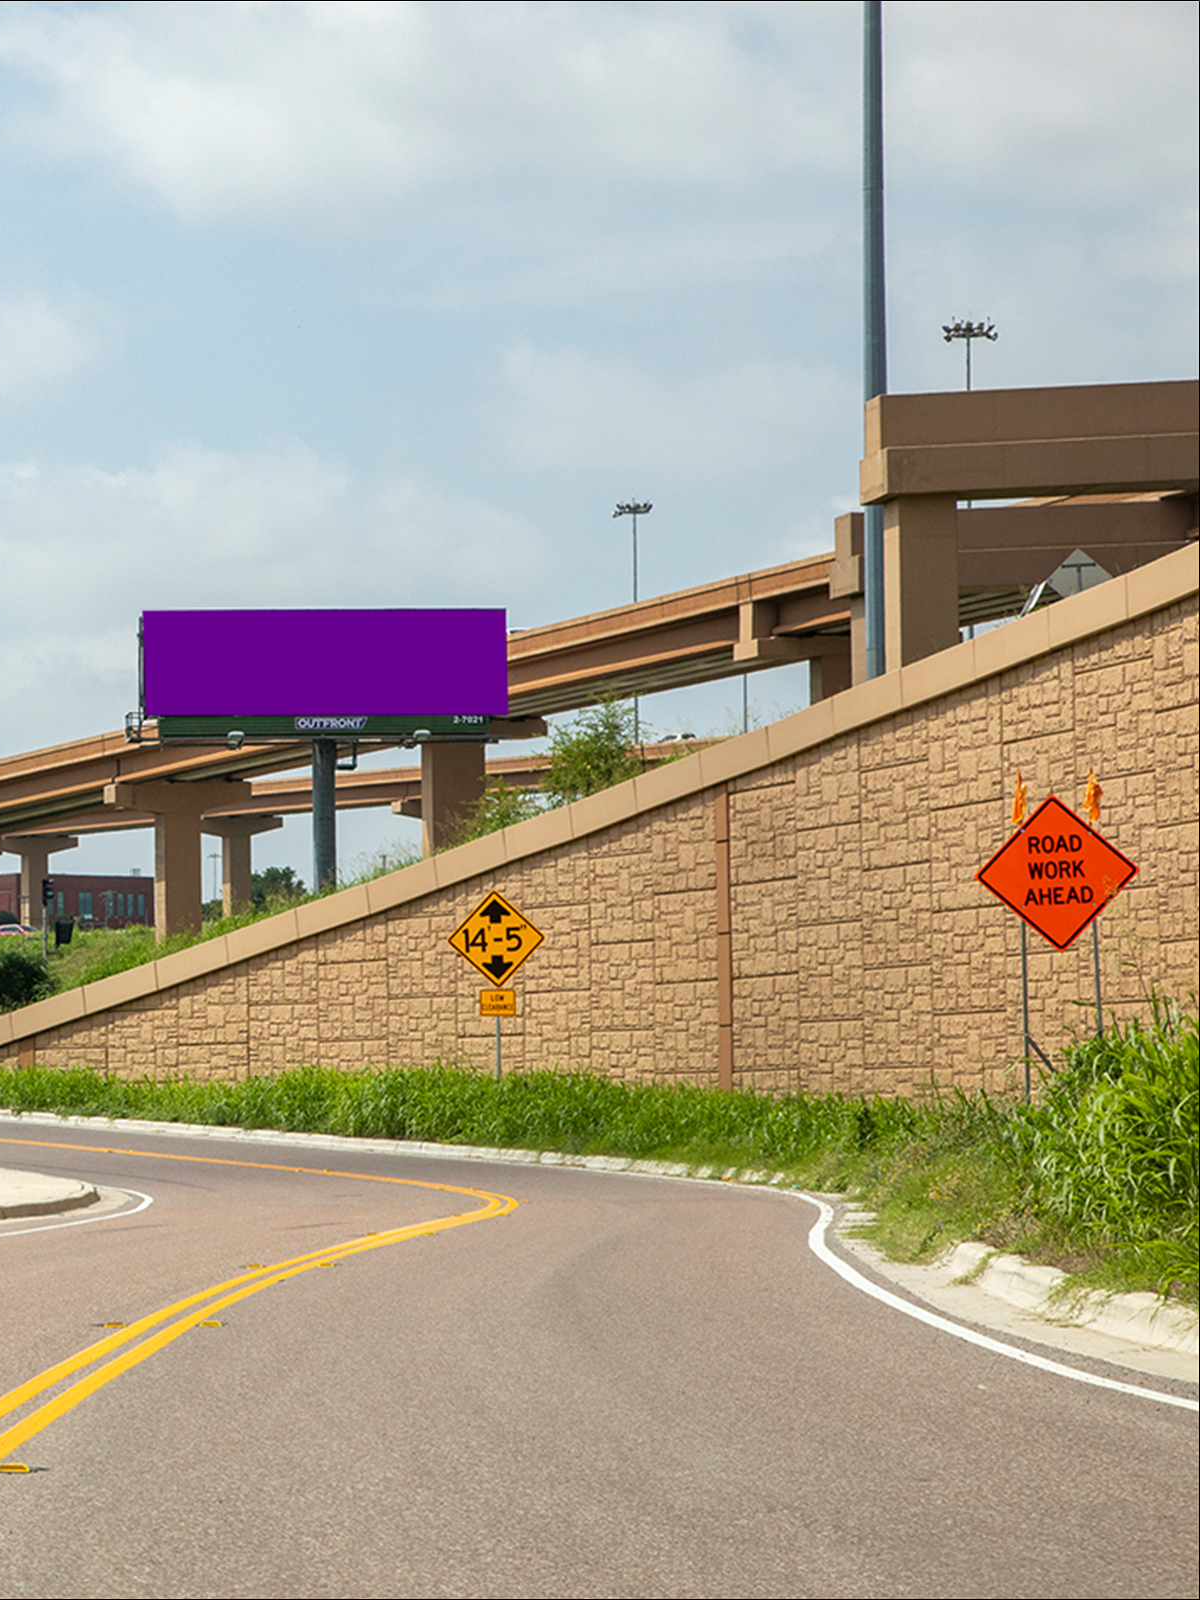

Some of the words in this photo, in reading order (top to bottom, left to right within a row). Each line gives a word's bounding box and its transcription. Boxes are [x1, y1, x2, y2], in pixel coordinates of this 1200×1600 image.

[297, 717, 363, 729] OUTFRONT
[453, 715, 483, 724] 2-7021
[1028, 835, 1082, 854] ROAD
[1028, 860, 1086, 880] WORK
[1024, 886, 1094, 906] AHEAD
[490, 994, 504, 1003] LOW
